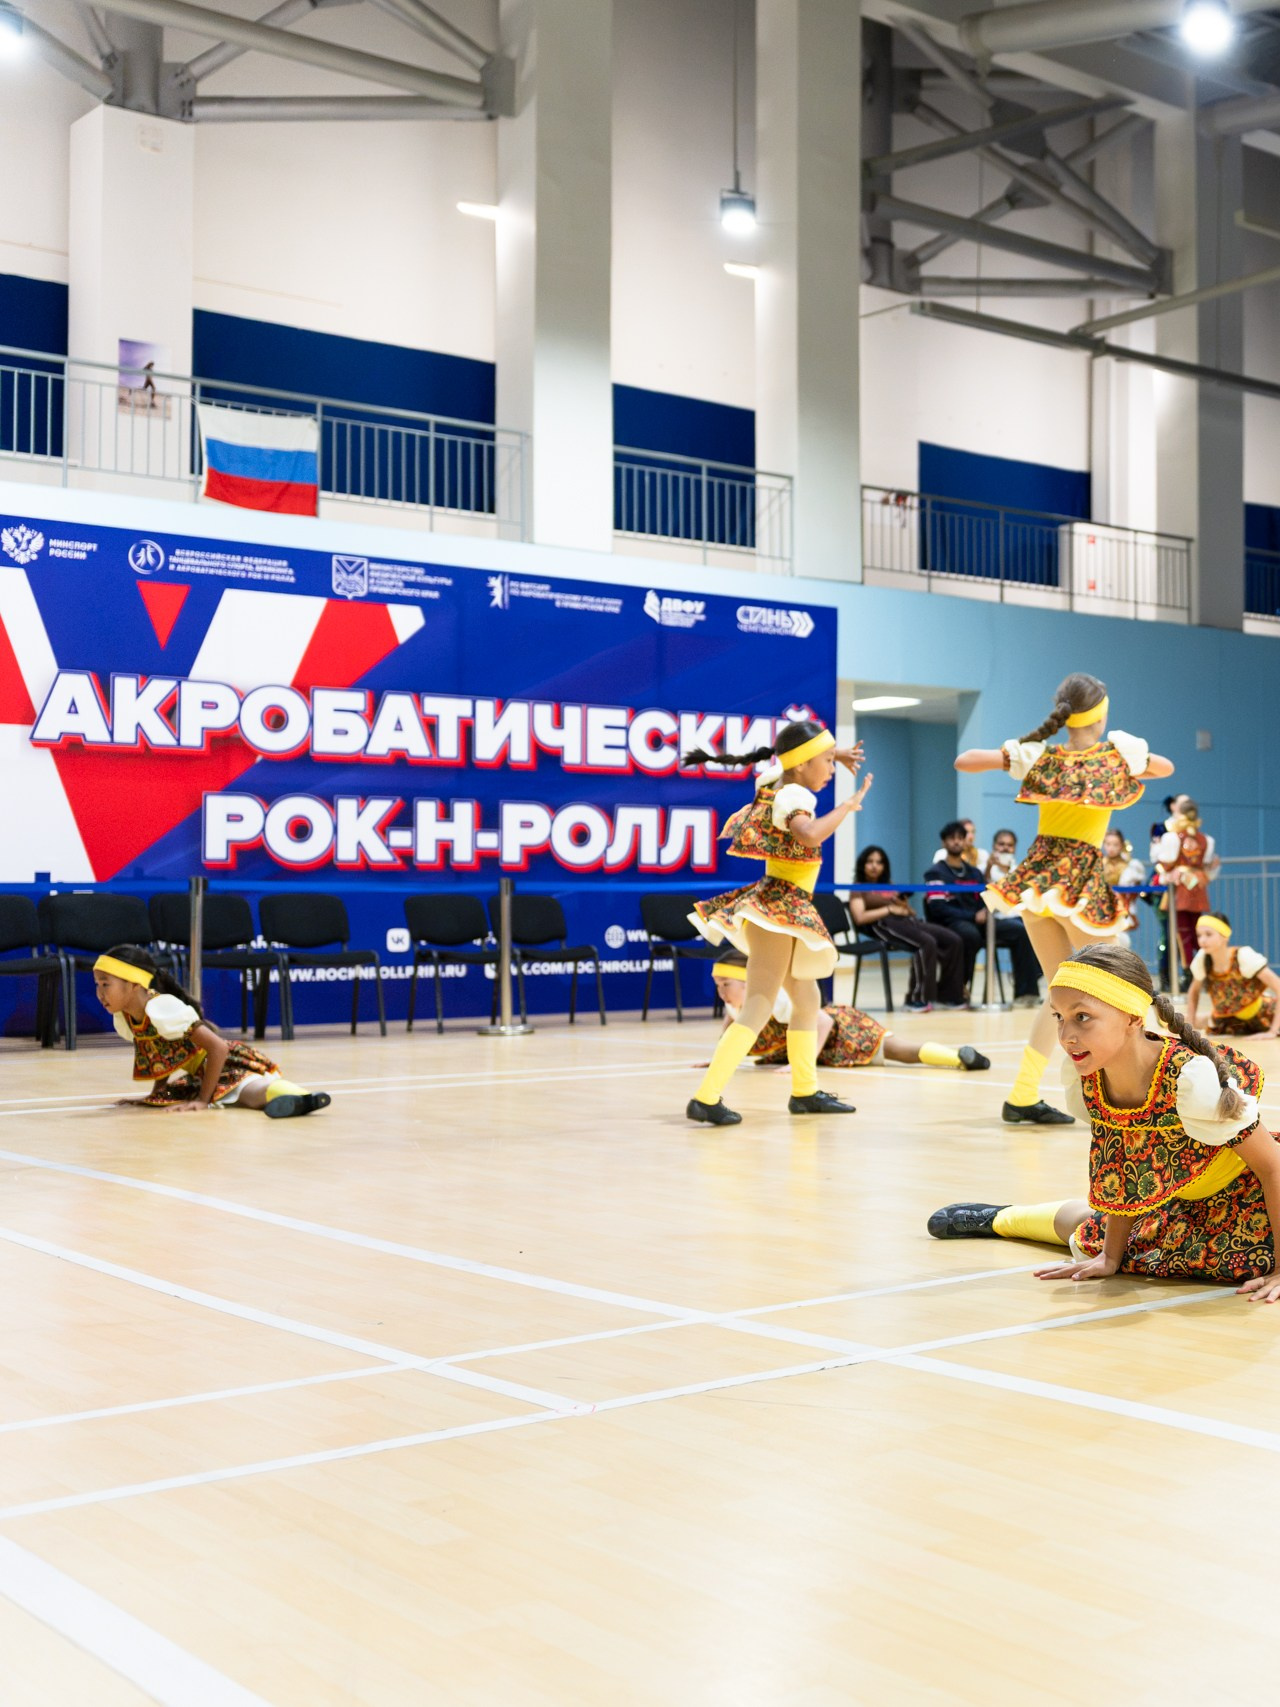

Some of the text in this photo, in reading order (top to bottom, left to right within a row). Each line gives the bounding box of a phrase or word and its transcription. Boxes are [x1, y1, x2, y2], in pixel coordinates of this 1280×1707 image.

[49, 538, 97, 552] МИНСПОРТ
[49, 548, 87, 560] РОССИИ
[661, 597, 706, 613] ДВФУ
[736, 605, 793, 629] СТАНЬ
[28, 669, 826, 779] АКРОБАТИЧЕСКИ
[202, 791, 716, 873] РОК-Н-РОЛЛ
